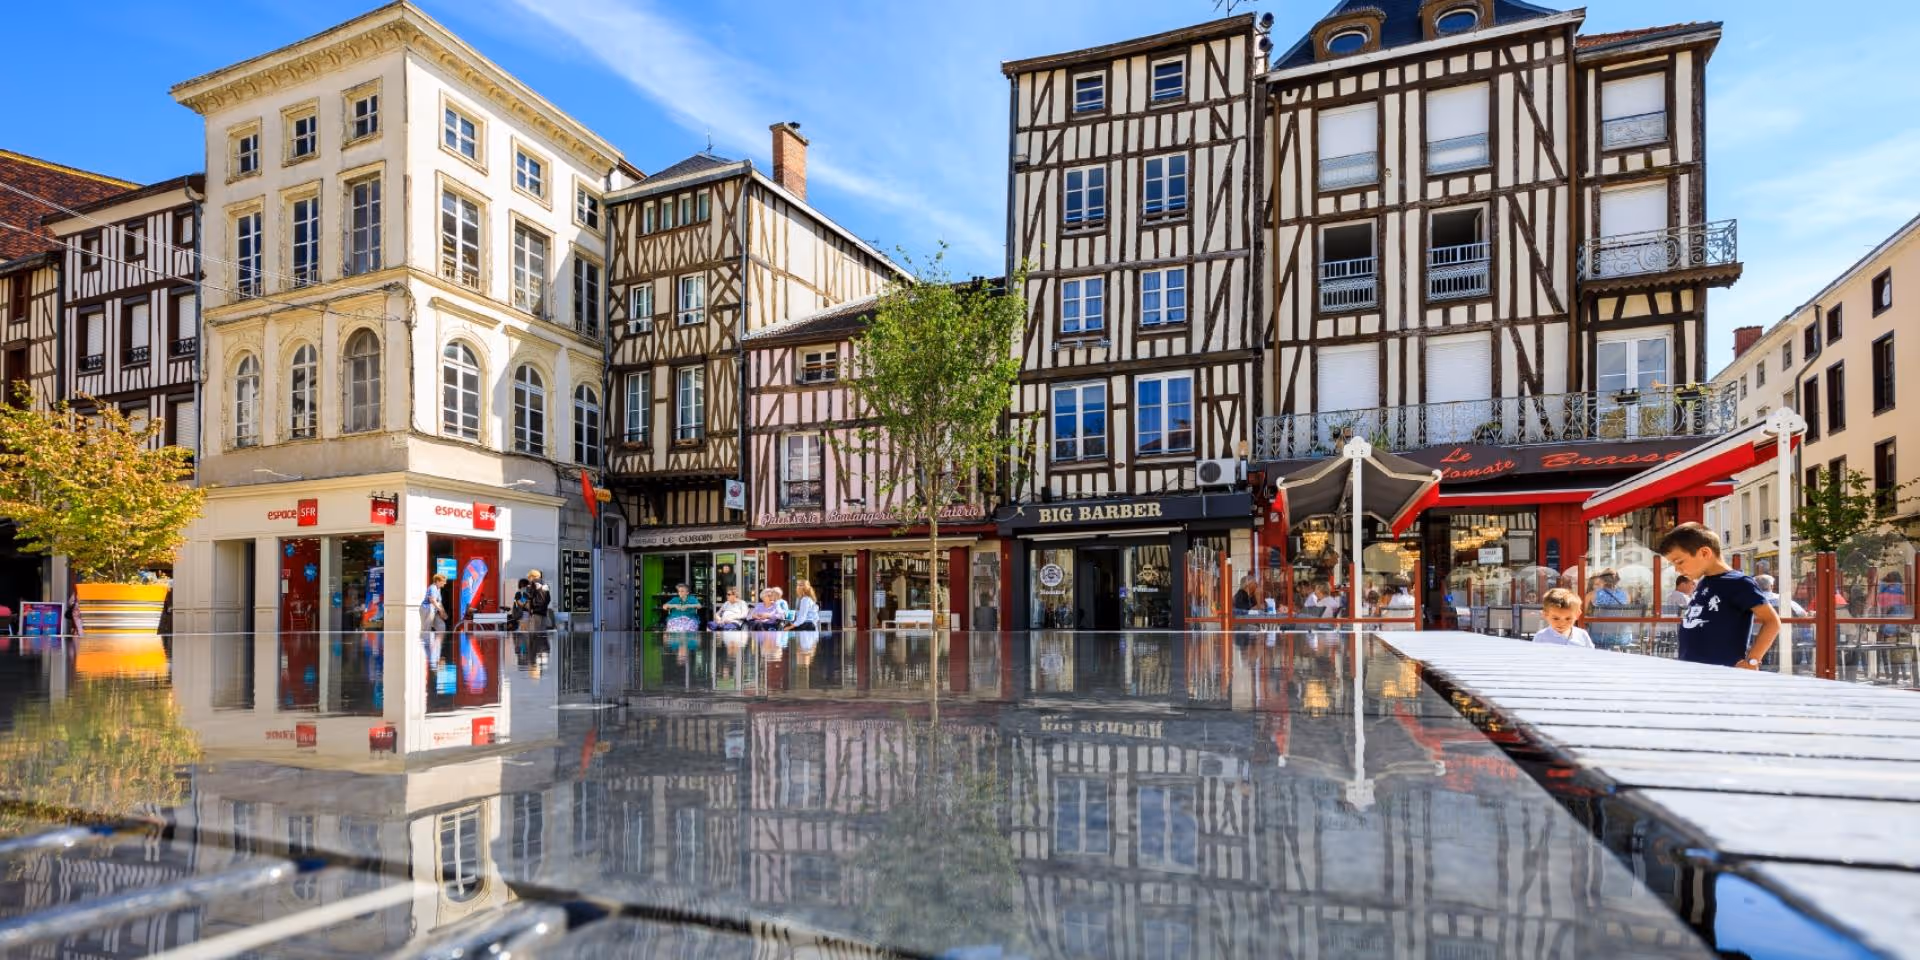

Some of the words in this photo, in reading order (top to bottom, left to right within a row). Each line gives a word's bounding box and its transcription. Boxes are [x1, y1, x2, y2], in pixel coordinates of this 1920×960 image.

[1440, 448, 1473, 463] Le
[1541, 451, 1682, 469] Brasse
[1442, 460, 1517, 479] lomate
[267, 508, 297, 520] espace
[300, 507, 316, 518] SFR
[376, 506, 395, 518] SFR
[435, 505, 473, 520] espace
[480, 511, 496, 521] SFR
[1039, 506, 1073, 523] BIG
[1079, 502, 1163, 521] BARBER
[662, 536, 674, 545] LE
